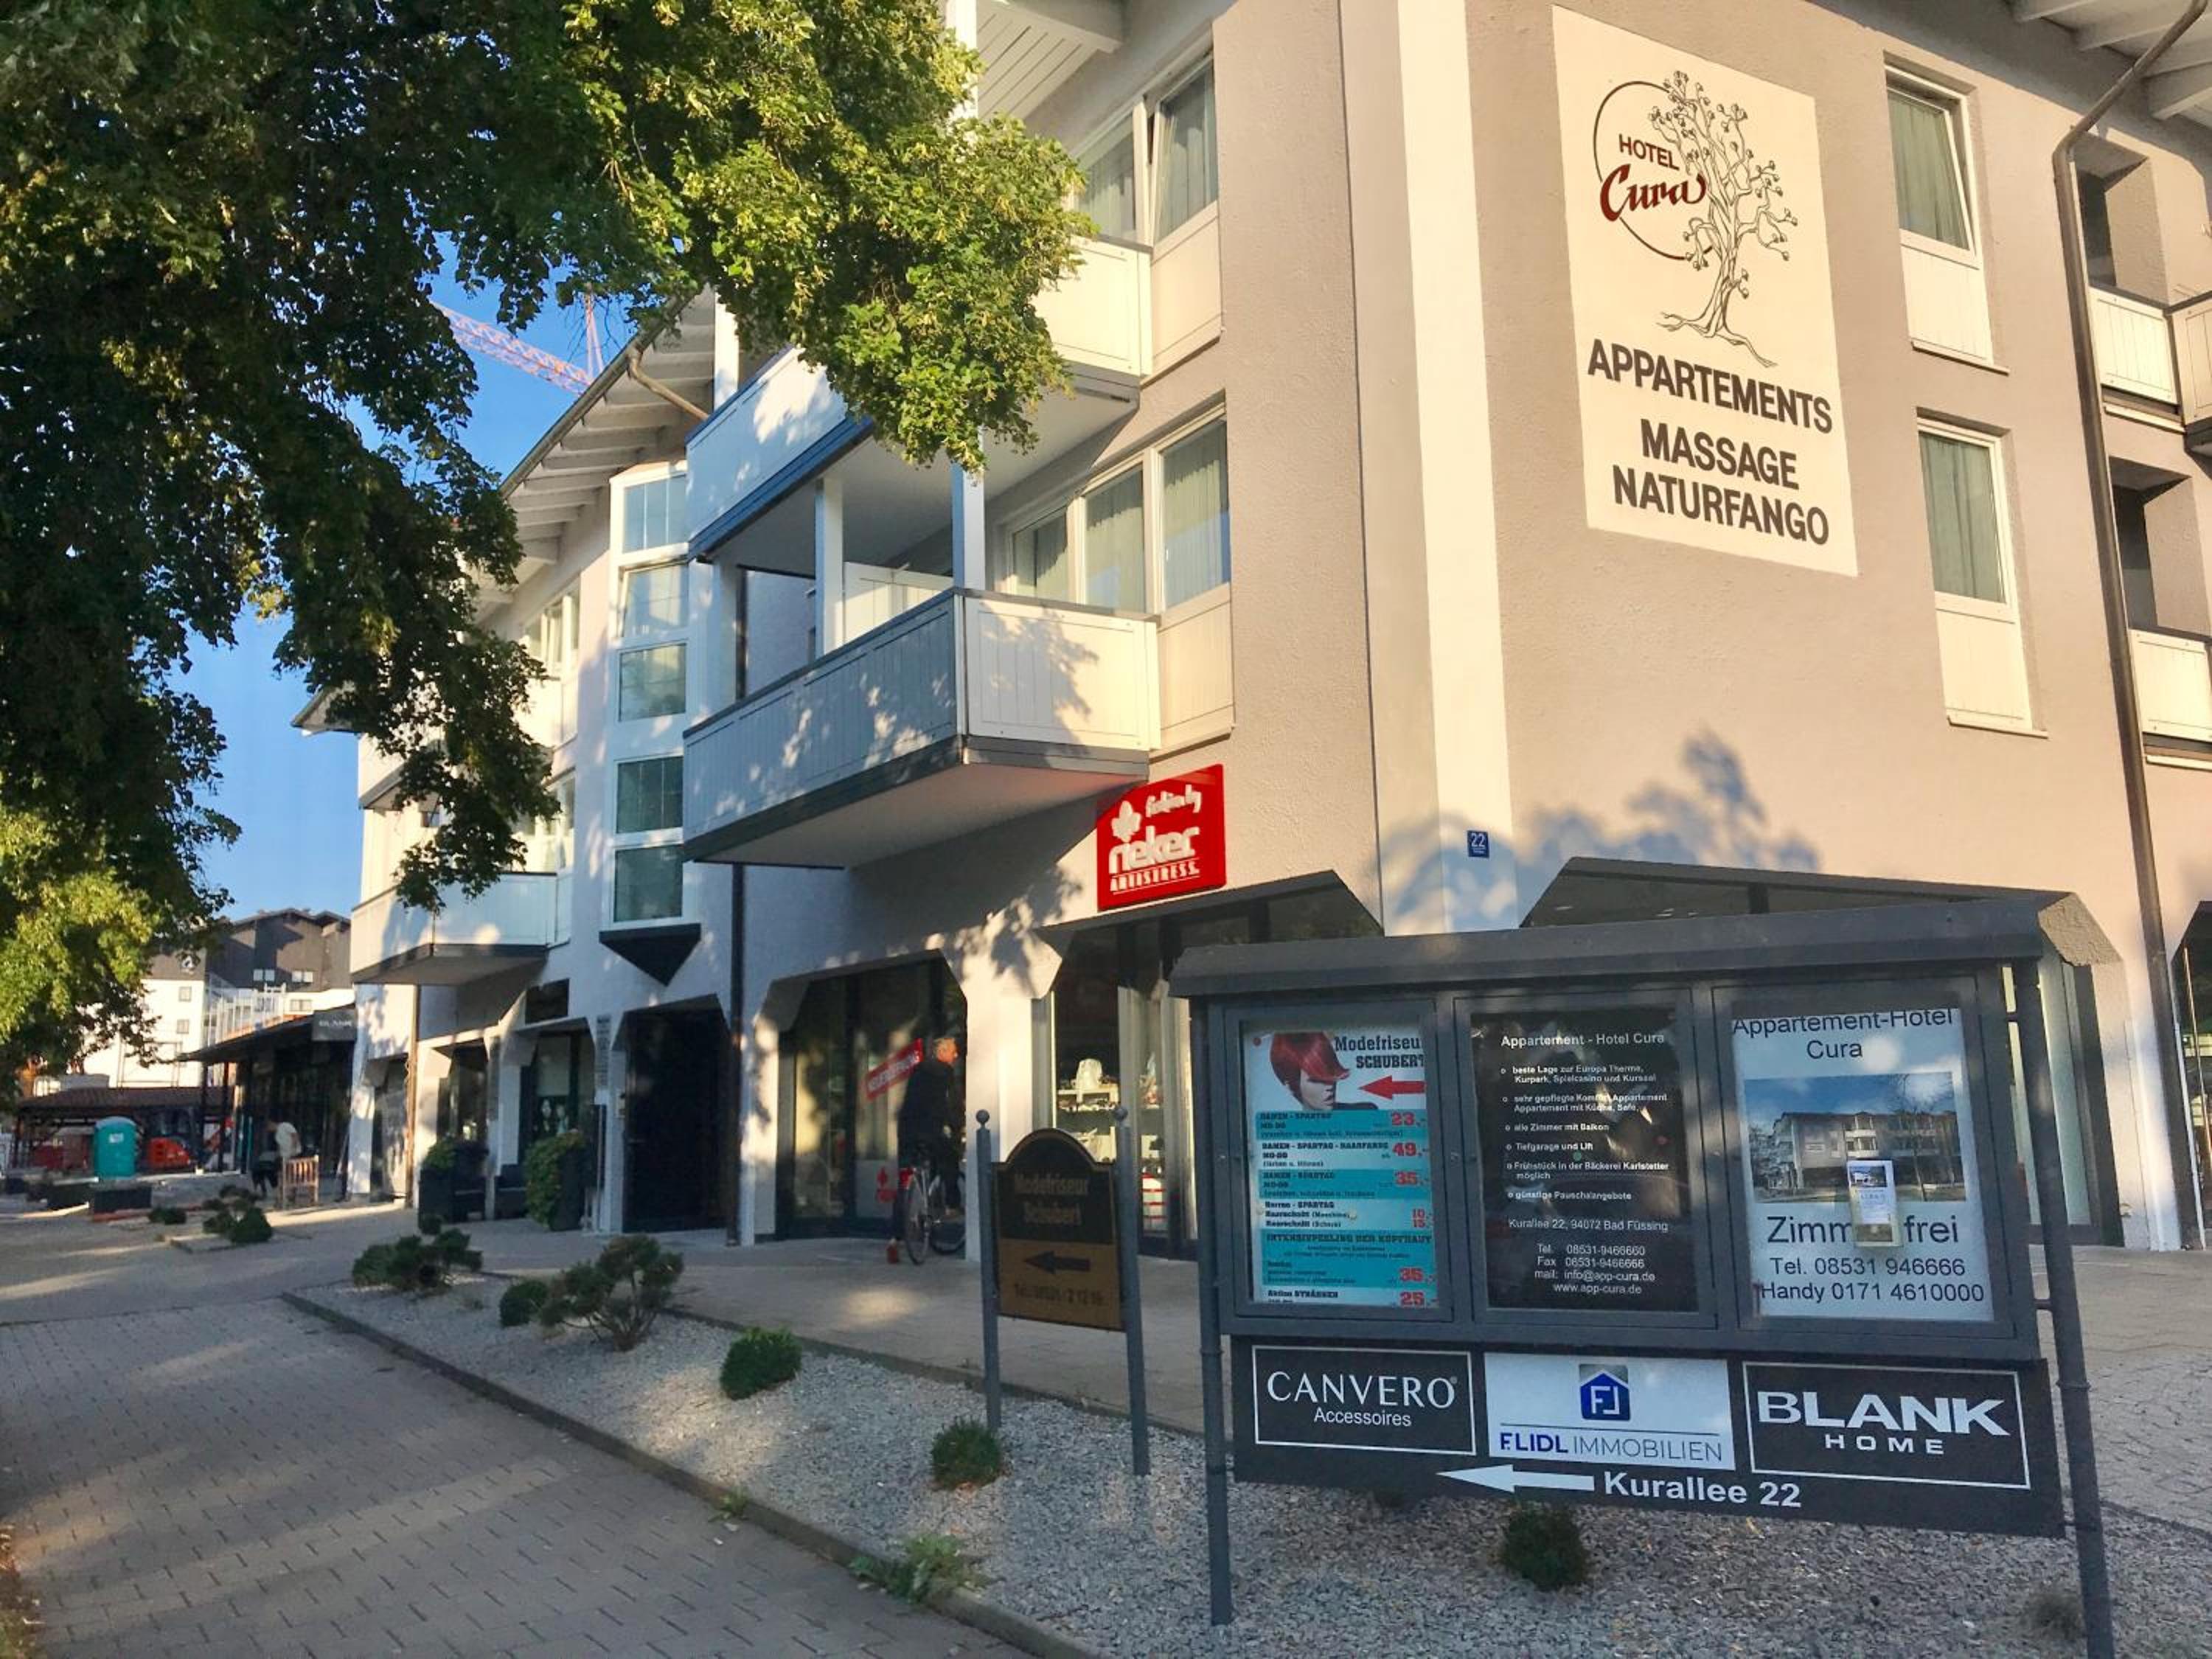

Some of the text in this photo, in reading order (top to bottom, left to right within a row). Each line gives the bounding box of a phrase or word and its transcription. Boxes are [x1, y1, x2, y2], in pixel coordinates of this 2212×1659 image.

[1618, 133, 1680, 171] HOTEL
[1600, 164, 1706, 221] Cura
[1587, 338, 1832, 434] APPARTEMENTS
[1641, 418, 1799, 490] MASSAGE
[1613, 465, 1829, 545] NATURFANGO
[1471, 832, 1486, 847] 22
[1733, 1008, 1953, 1039] Appartement-Hotel
[1334, 1034, 1422, 1051] Modefriseu
[1501, 1034, 1585, 1048] Appartement
[1596, 1033, 1629, 1044] Hotel
[1633, 1033, 1665, 1044] Cura
[1806, 1040, 1863, 1060] Cura
[1512, 1066, 1536, 1074] beste
[1537, 1065, 1558, 1075] Lage
[1576, 1065, 1607, 1074] Europa
[1554, 1075, 1602, 1084] Spielcasino
[1530, 1123, 1562, 1132] Zimmer
[1516, 1143, 1559, 1152] Tiefgarage
[1580, 1142, 1593, 1150] Lift
[1514, 1161, 1557, 1170] Frühstück
[1558, 1161, 1567, 1170] in
[1569, 1161, 1583, 1170] der
[1517, 1172, 1551, 1181] möglich
[1571, 1219, 1601, 1230] 94072
[1604, 1220, 1624, 1231] Bad
[1627, 1220, 1669, 1234] Füssing
[1767, 1215, 1959, 1243] Zimm frei
[1537, 1256, 1557, 1266] Fax
[1770, 1257, 1966, 1276] Tel. 08531 946666
[1564, 1269, 1655, 1282] info@app-cura.de
[1761, 1282, 1984, 1303] Handy 0171 4610000
[1314, 1406, 1411, 1427] Accessoires
[1757, 1391, 2010, 1436] BLANK
[1573, 1436, 1722, 1462] IMMOBILIEN
[1824, 1433, 1944, 1455] HOME
[1604, 1471, 1801, 1508] Kurallee 22
